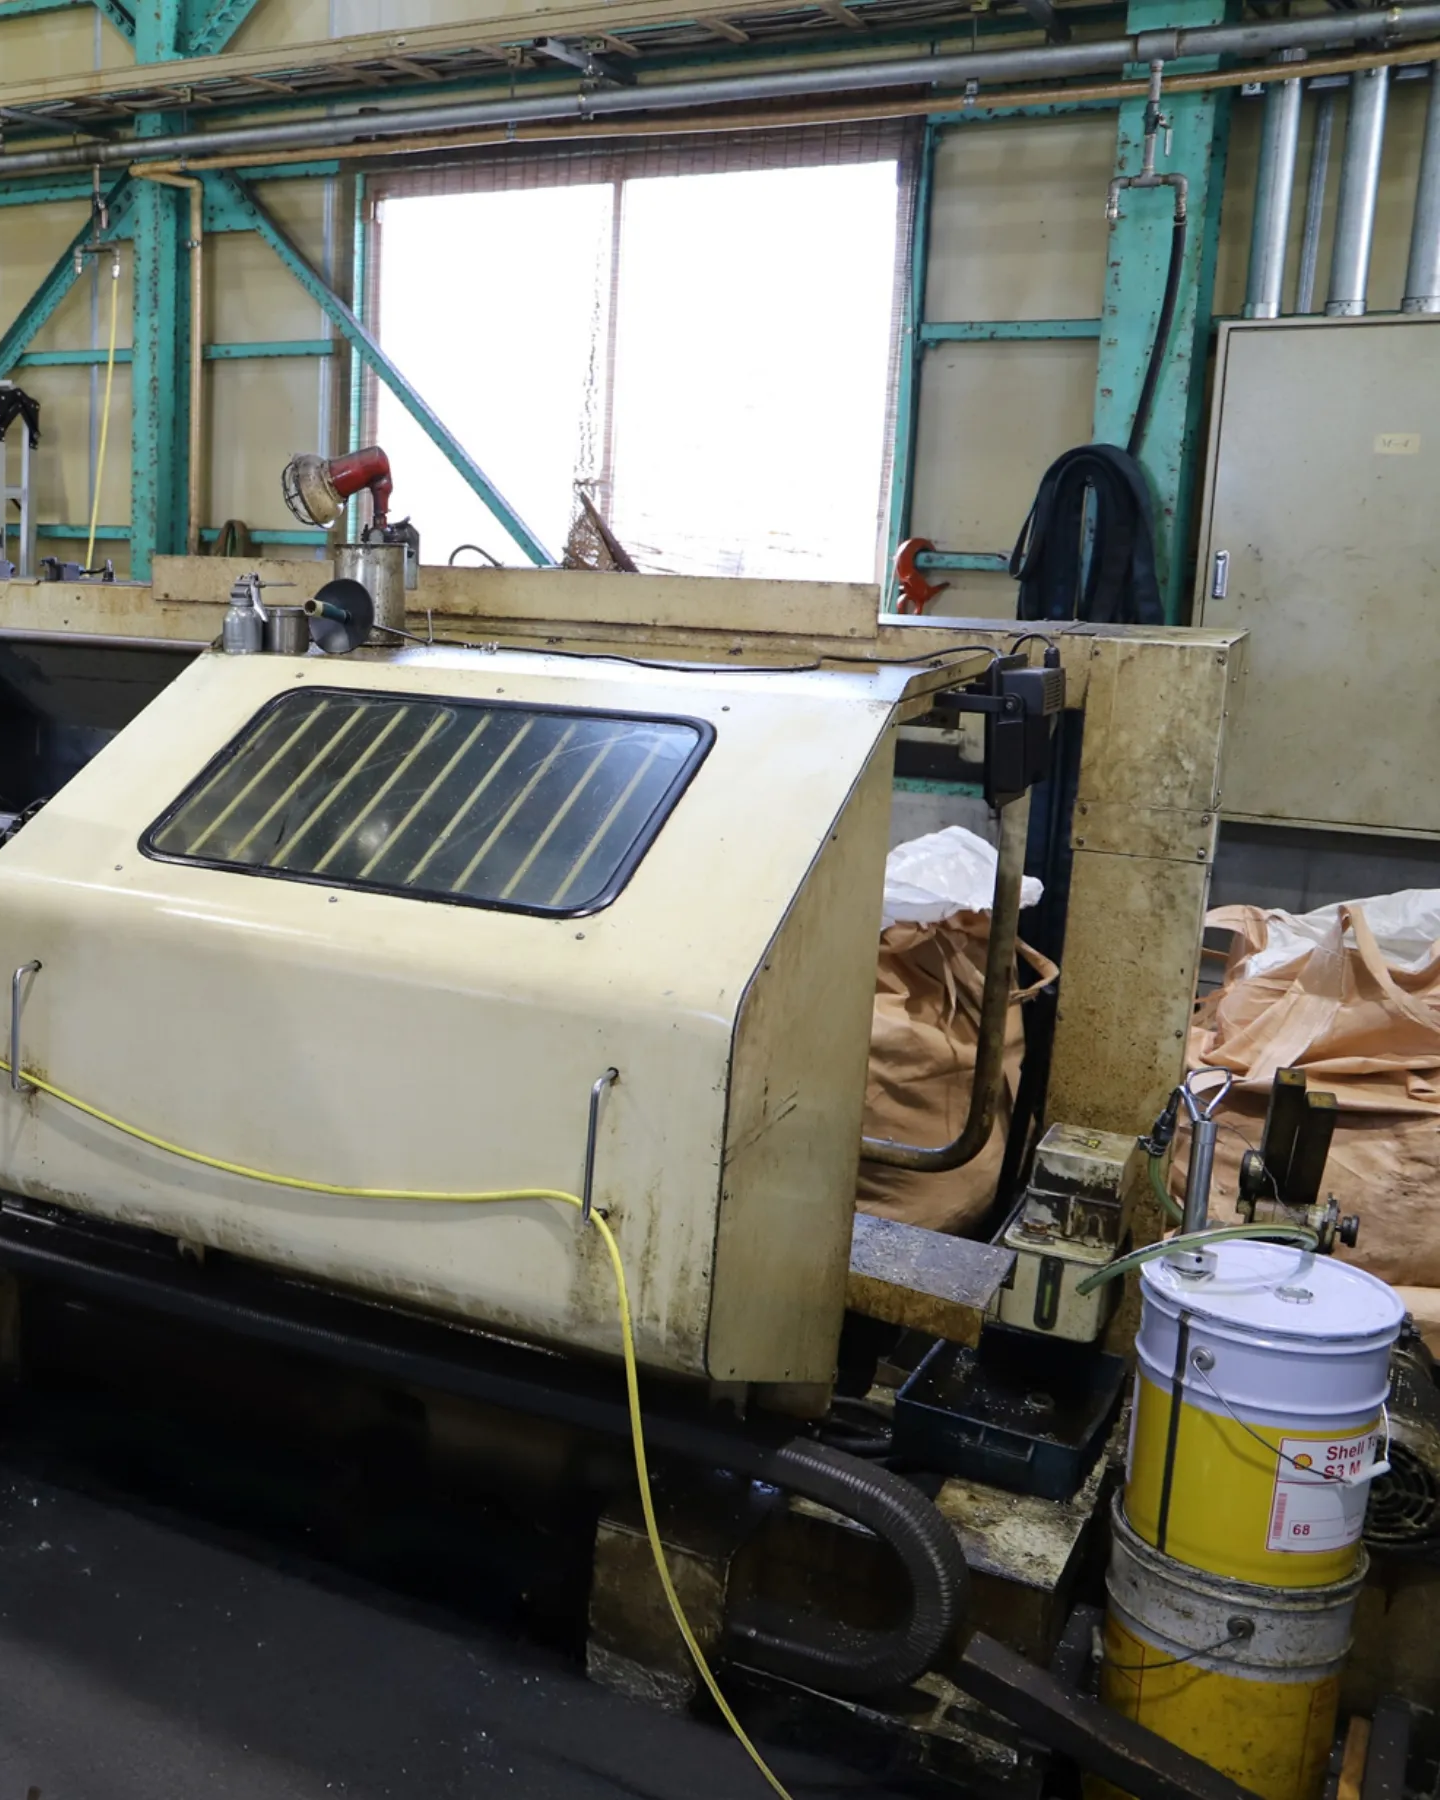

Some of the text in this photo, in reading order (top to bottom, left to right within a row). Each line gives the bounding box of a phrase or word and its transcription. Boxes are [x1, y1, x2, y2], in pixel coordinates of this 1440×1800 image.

[1325, 1440, 1365, 1461] Shell
[1323, 1464, 1345, 1480] S3
[1292, 1523, 1311, 1536] 68
